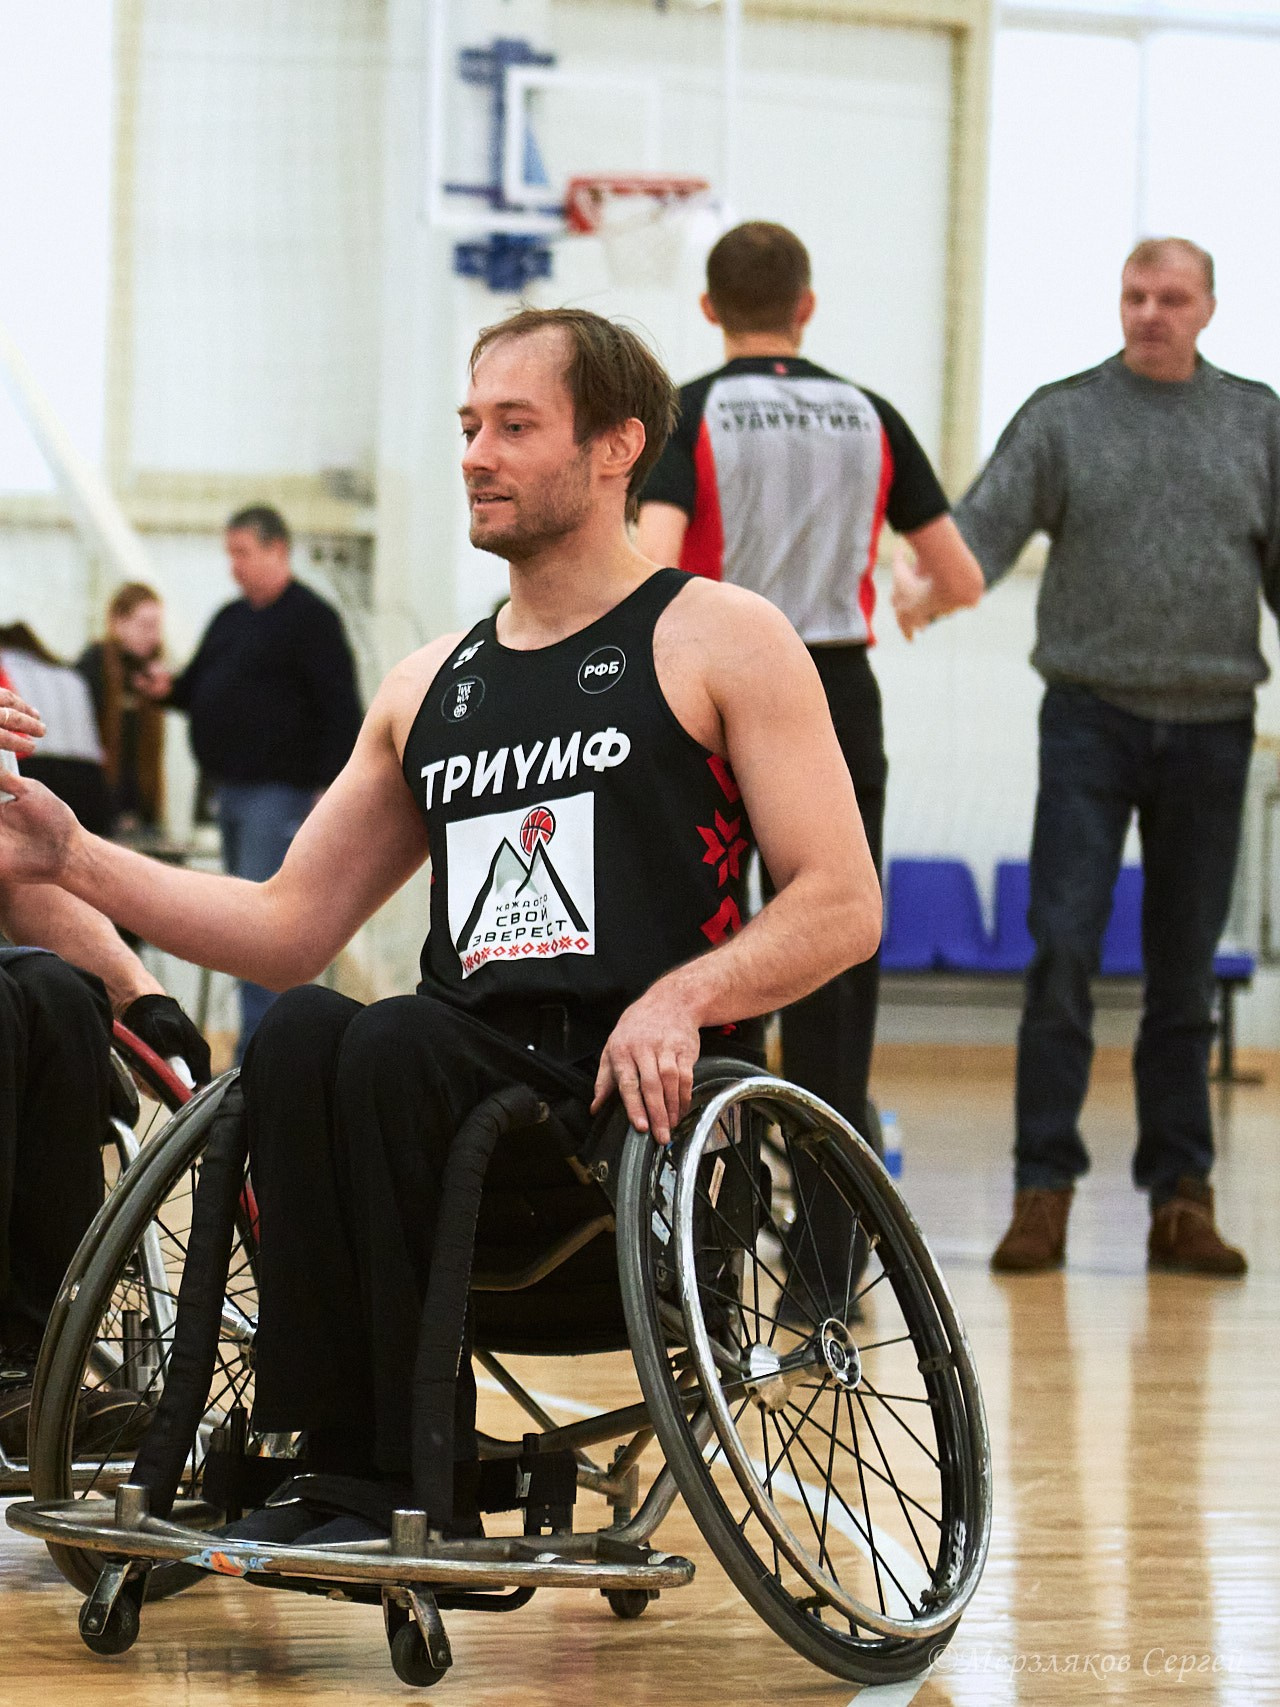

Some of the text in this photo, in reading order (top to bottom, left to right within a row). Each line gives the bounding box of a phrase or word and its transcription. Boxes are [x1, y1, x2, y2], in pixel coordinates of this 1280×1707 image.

[584, 661, 620, 678] РФБ
[421, 727, 631, 810] ТРИУМФ
[496, 905, 548, 927] СВОЙ
[473, 920, 567, 947] ЭВЕРЕСТ
